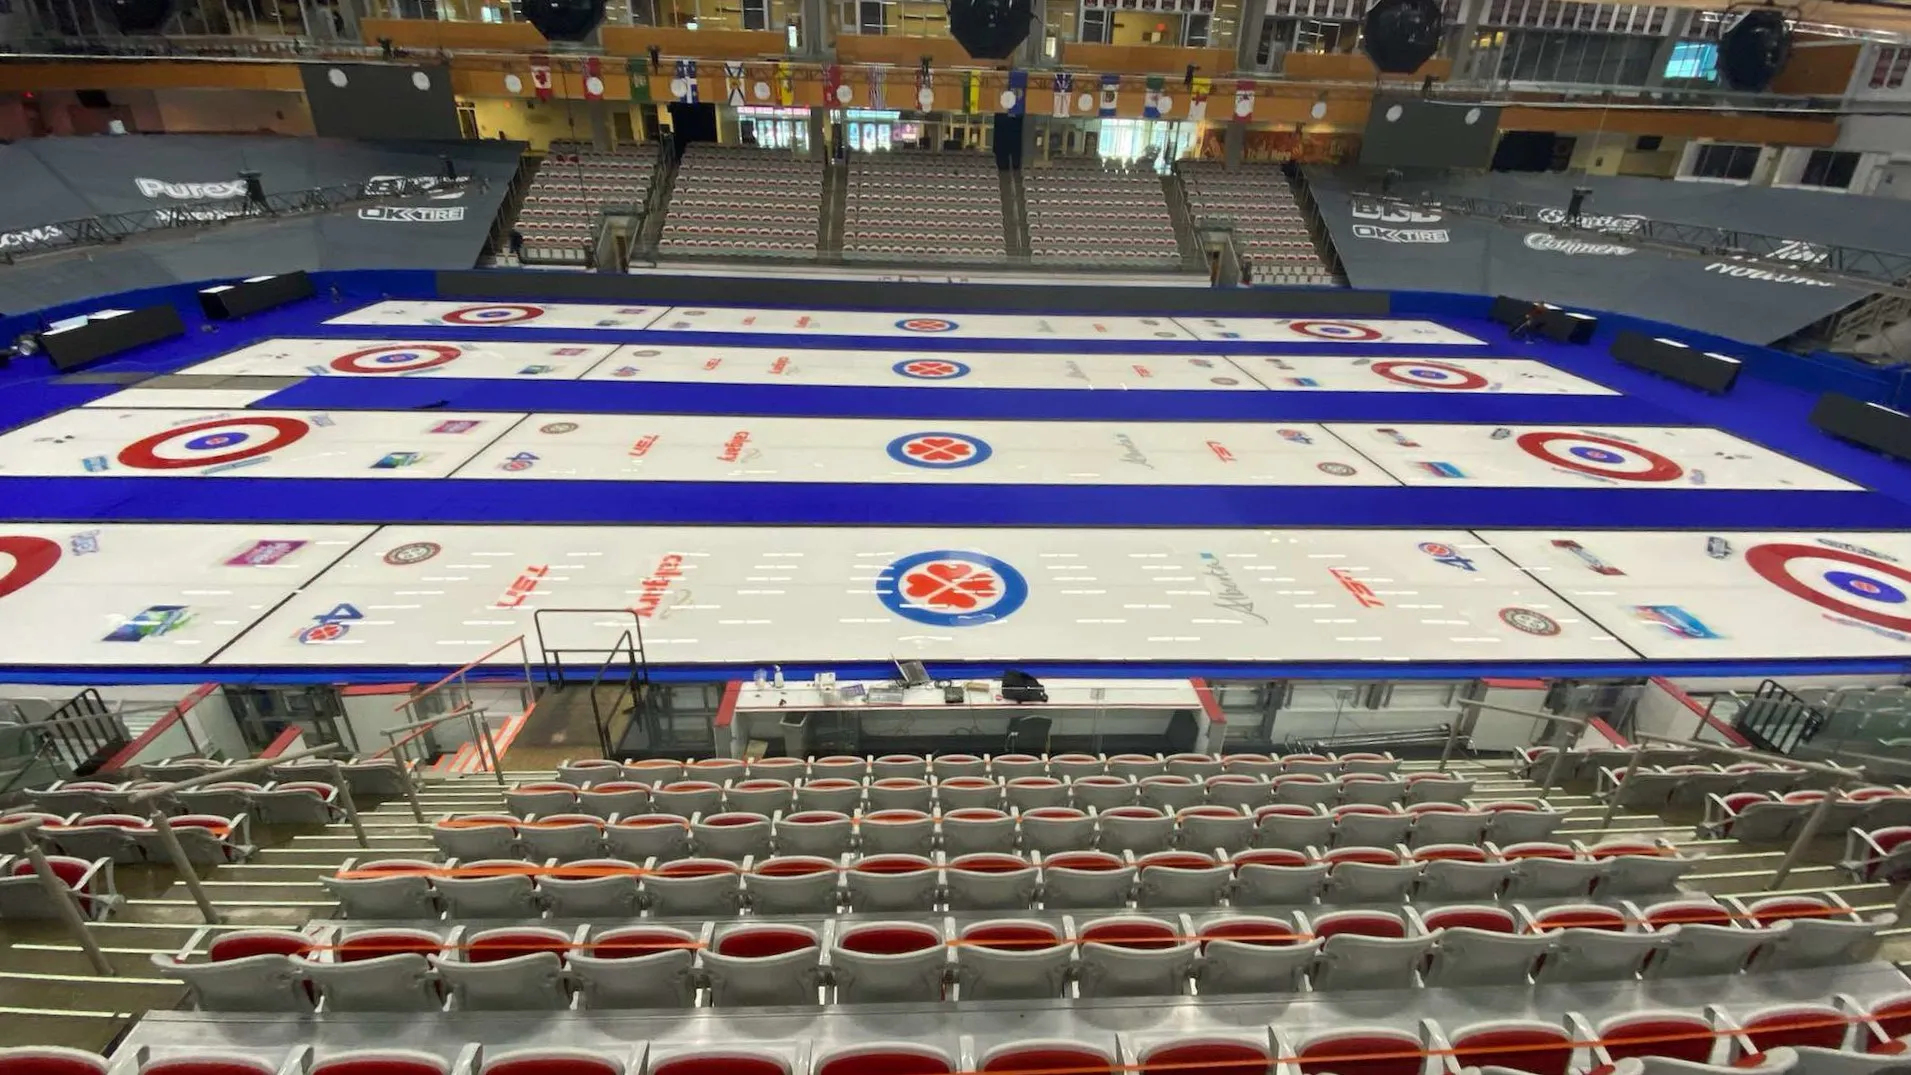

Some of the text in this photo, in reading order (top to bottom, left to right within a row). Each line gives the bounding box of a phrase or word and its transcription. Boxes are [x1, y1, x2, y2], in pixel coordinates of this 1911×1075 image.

[418, 207, 465, 221] TIRE
[1353, 224, 1450, 243] OK TIRE
[496, 564, 549, 610] TSN
[1327, 566, 1385, 608] TSN
